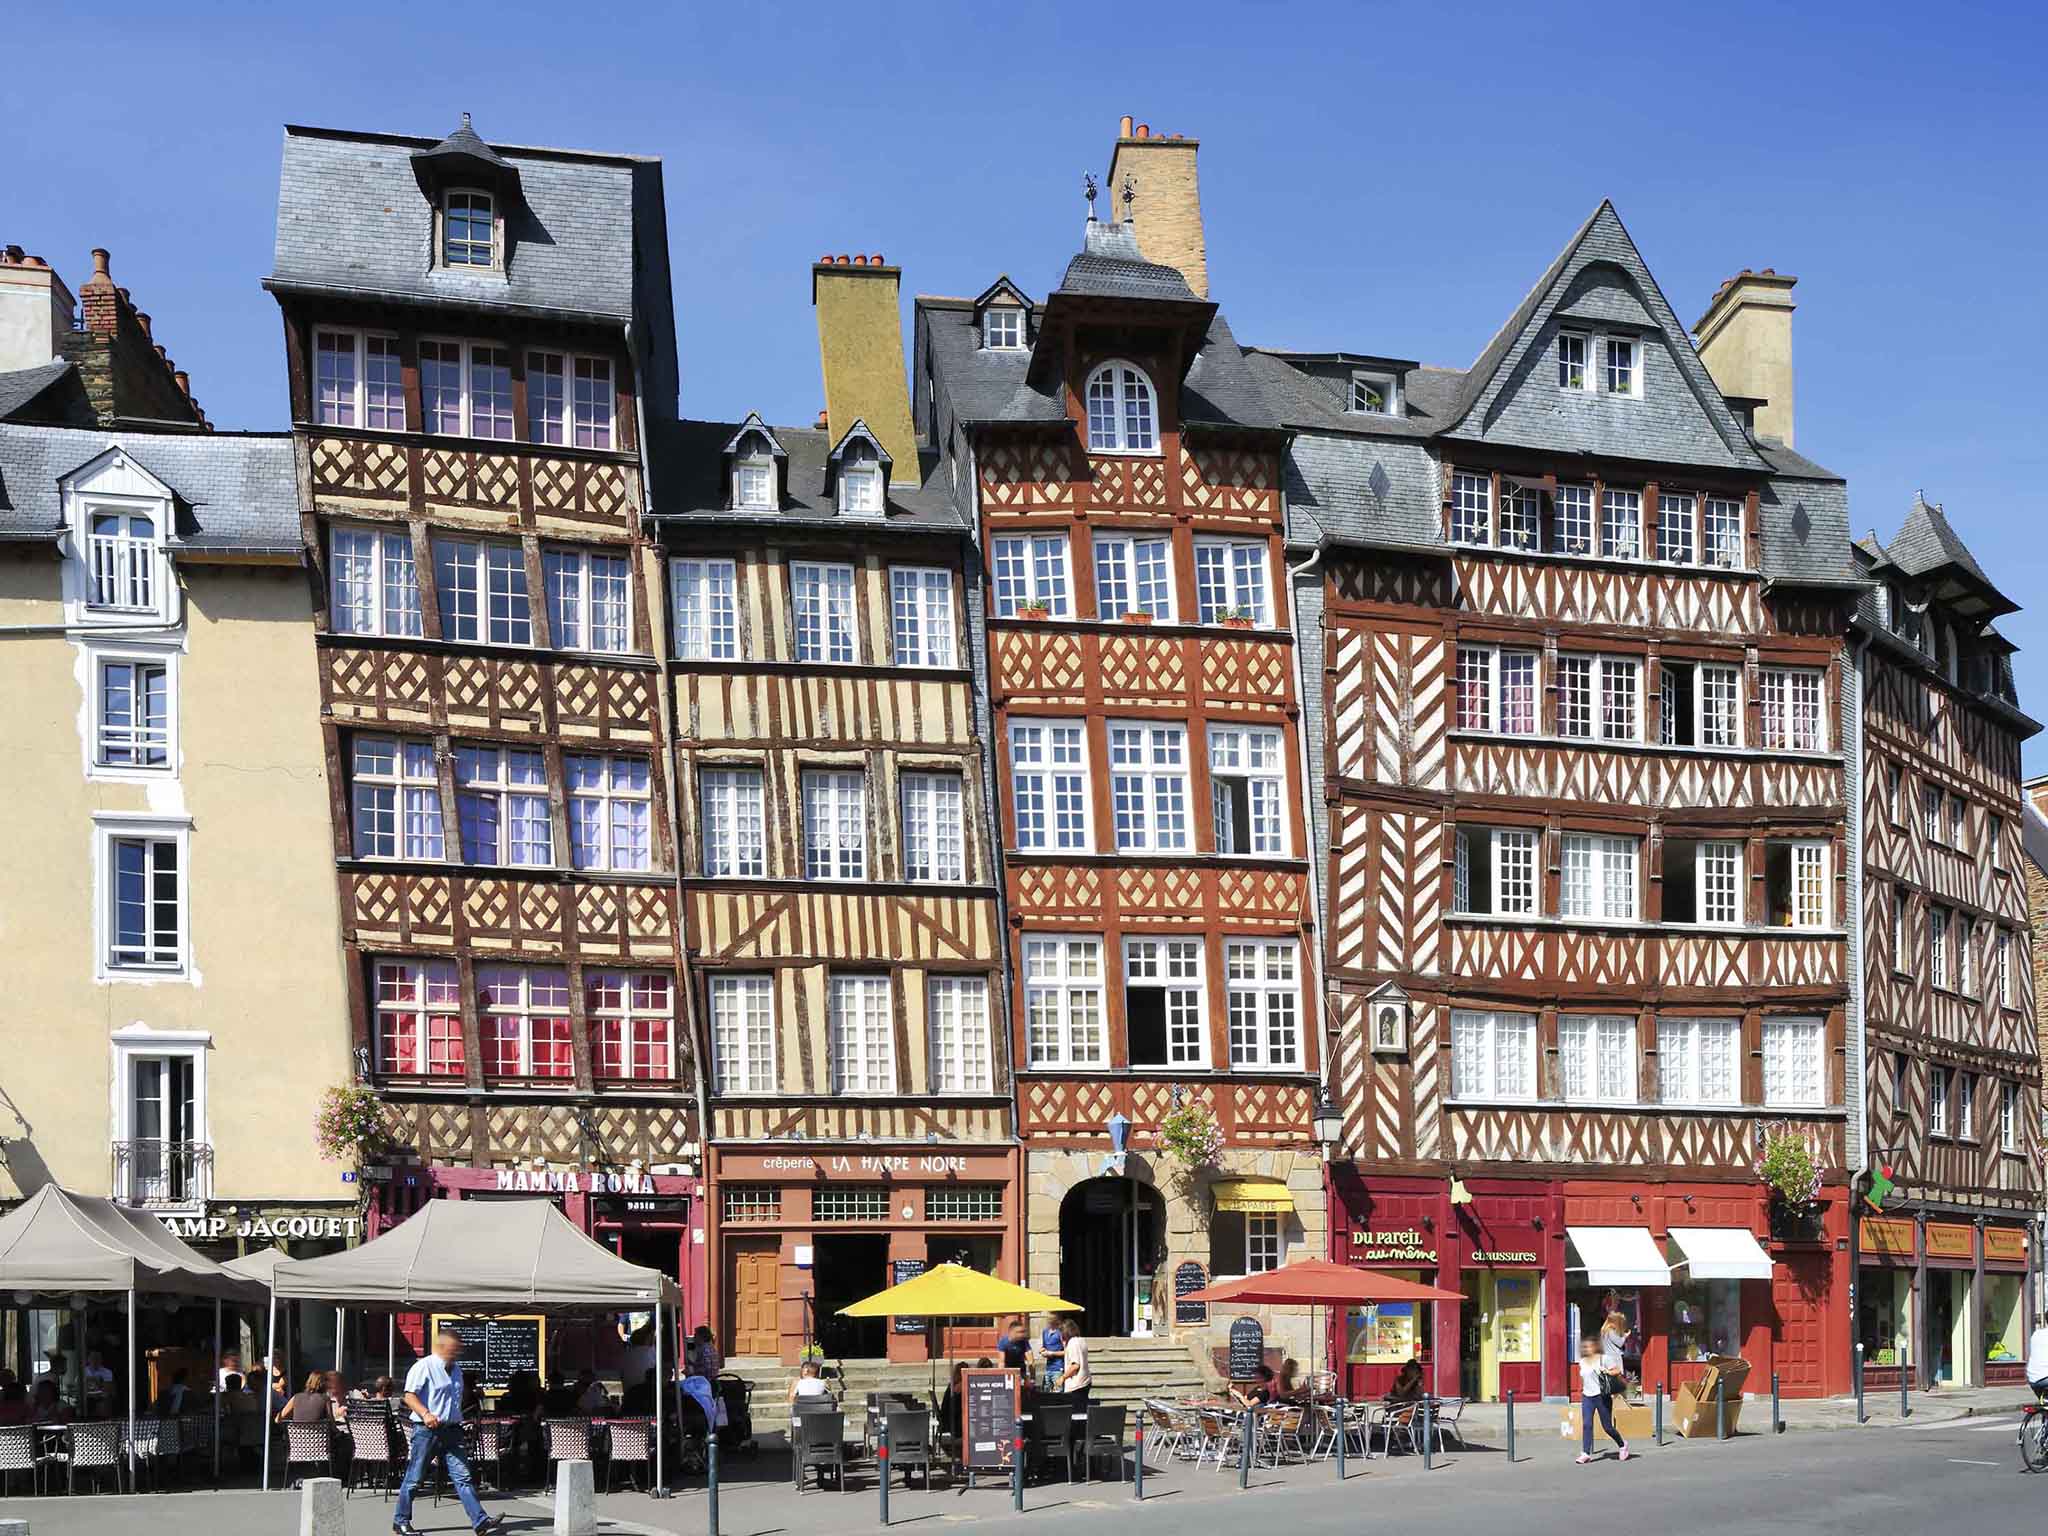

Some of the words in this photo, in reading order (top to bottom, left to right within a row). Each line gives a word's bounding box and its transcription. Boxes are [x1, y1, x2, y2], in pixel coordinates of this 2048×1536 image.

[763, 1157, 814, 1172] crêperie
[832, 1156, 851, 1172] LA
[861, 1156, 909, 1172] HARPE
[920, 1156, 967, 1173] NOIRE
[496, 1170, 580, 1192] MAMMA
[590, 1172, 655, 1194] ROMA
[165, 1217, 226, 1237] AMP
[236, 1216, 360, 1239] JACQUET
[1389, 1245, 1438, 1262] même
[1471, 1249, 1537, 1262] chaussures
